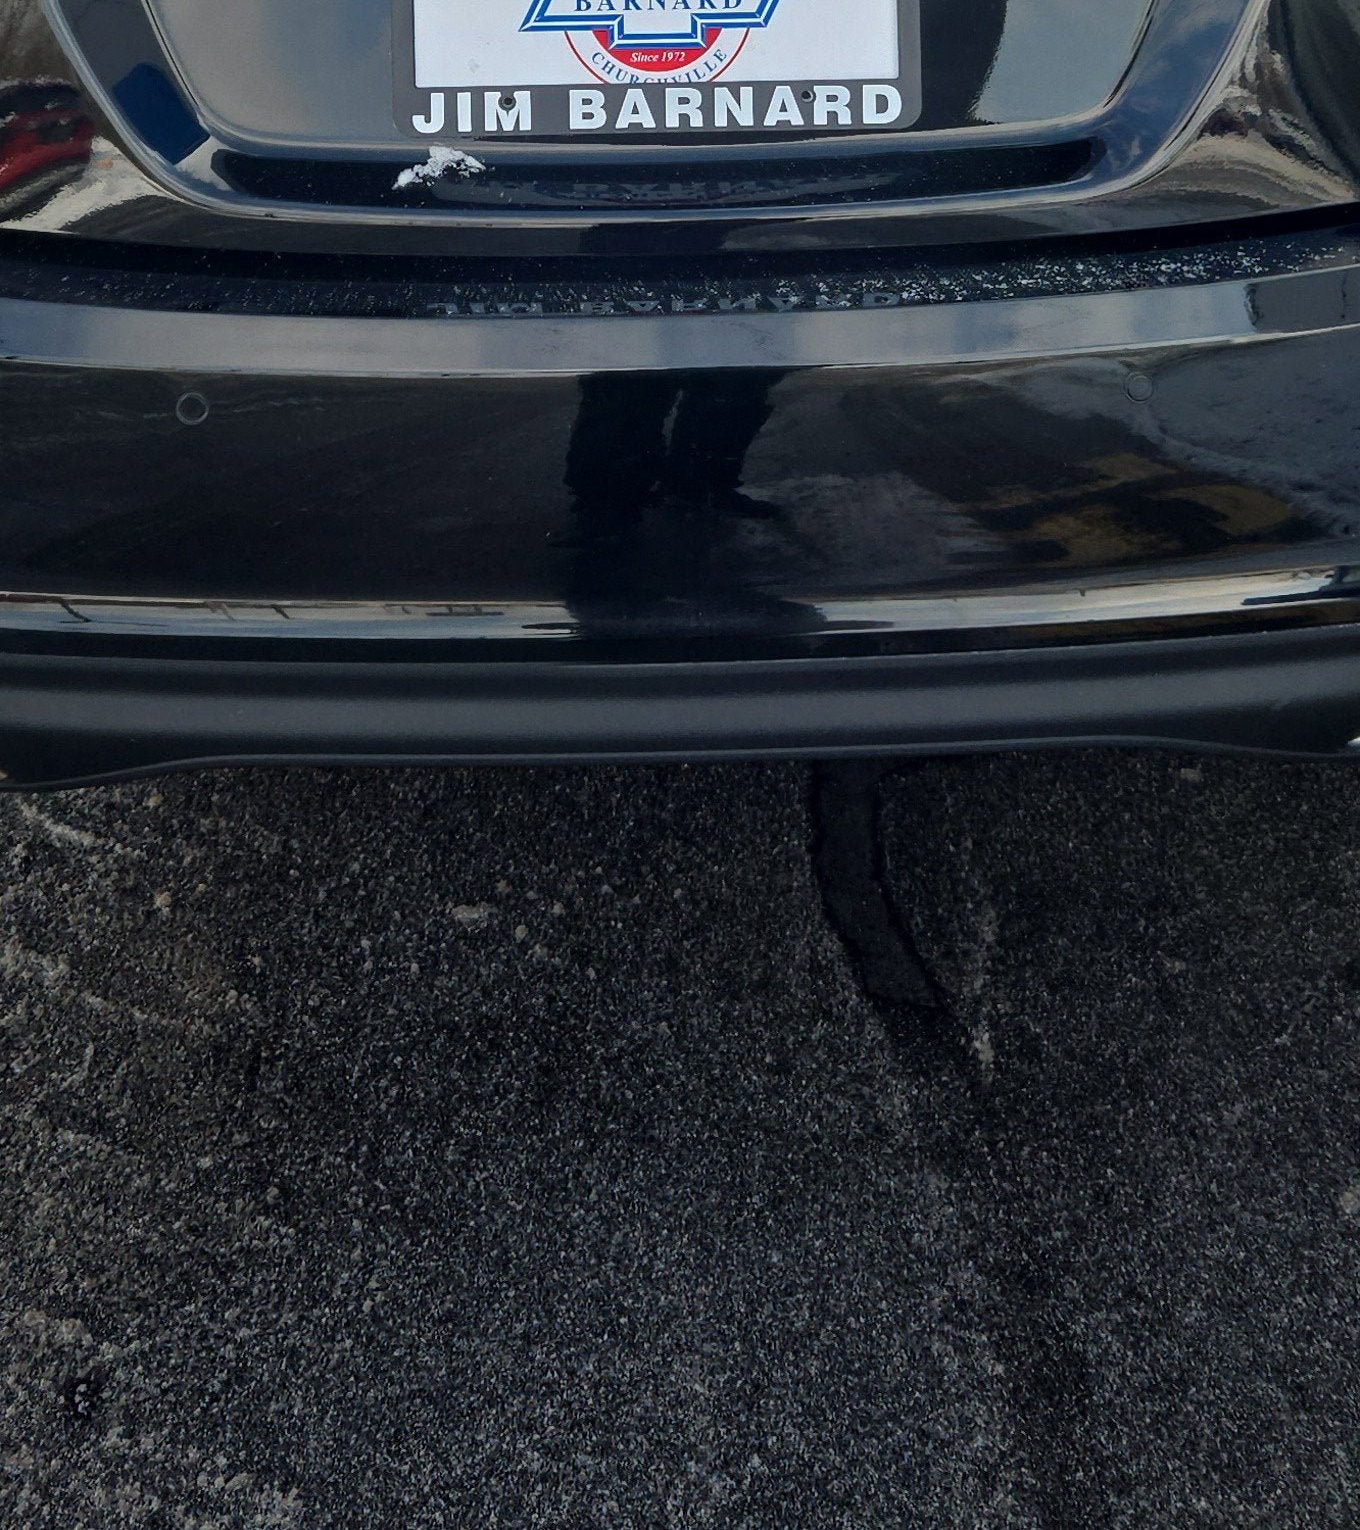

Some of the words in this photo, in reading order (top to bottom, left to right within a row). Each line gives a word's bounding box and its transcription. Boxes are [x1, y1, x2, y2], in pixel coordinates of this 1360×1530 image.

[630, 52, 658, 63] Since
[661, 52, 686, 62] 1972
[412, 90, 531, 134] JIM
[568, 84, 902, 130] BARNARD
